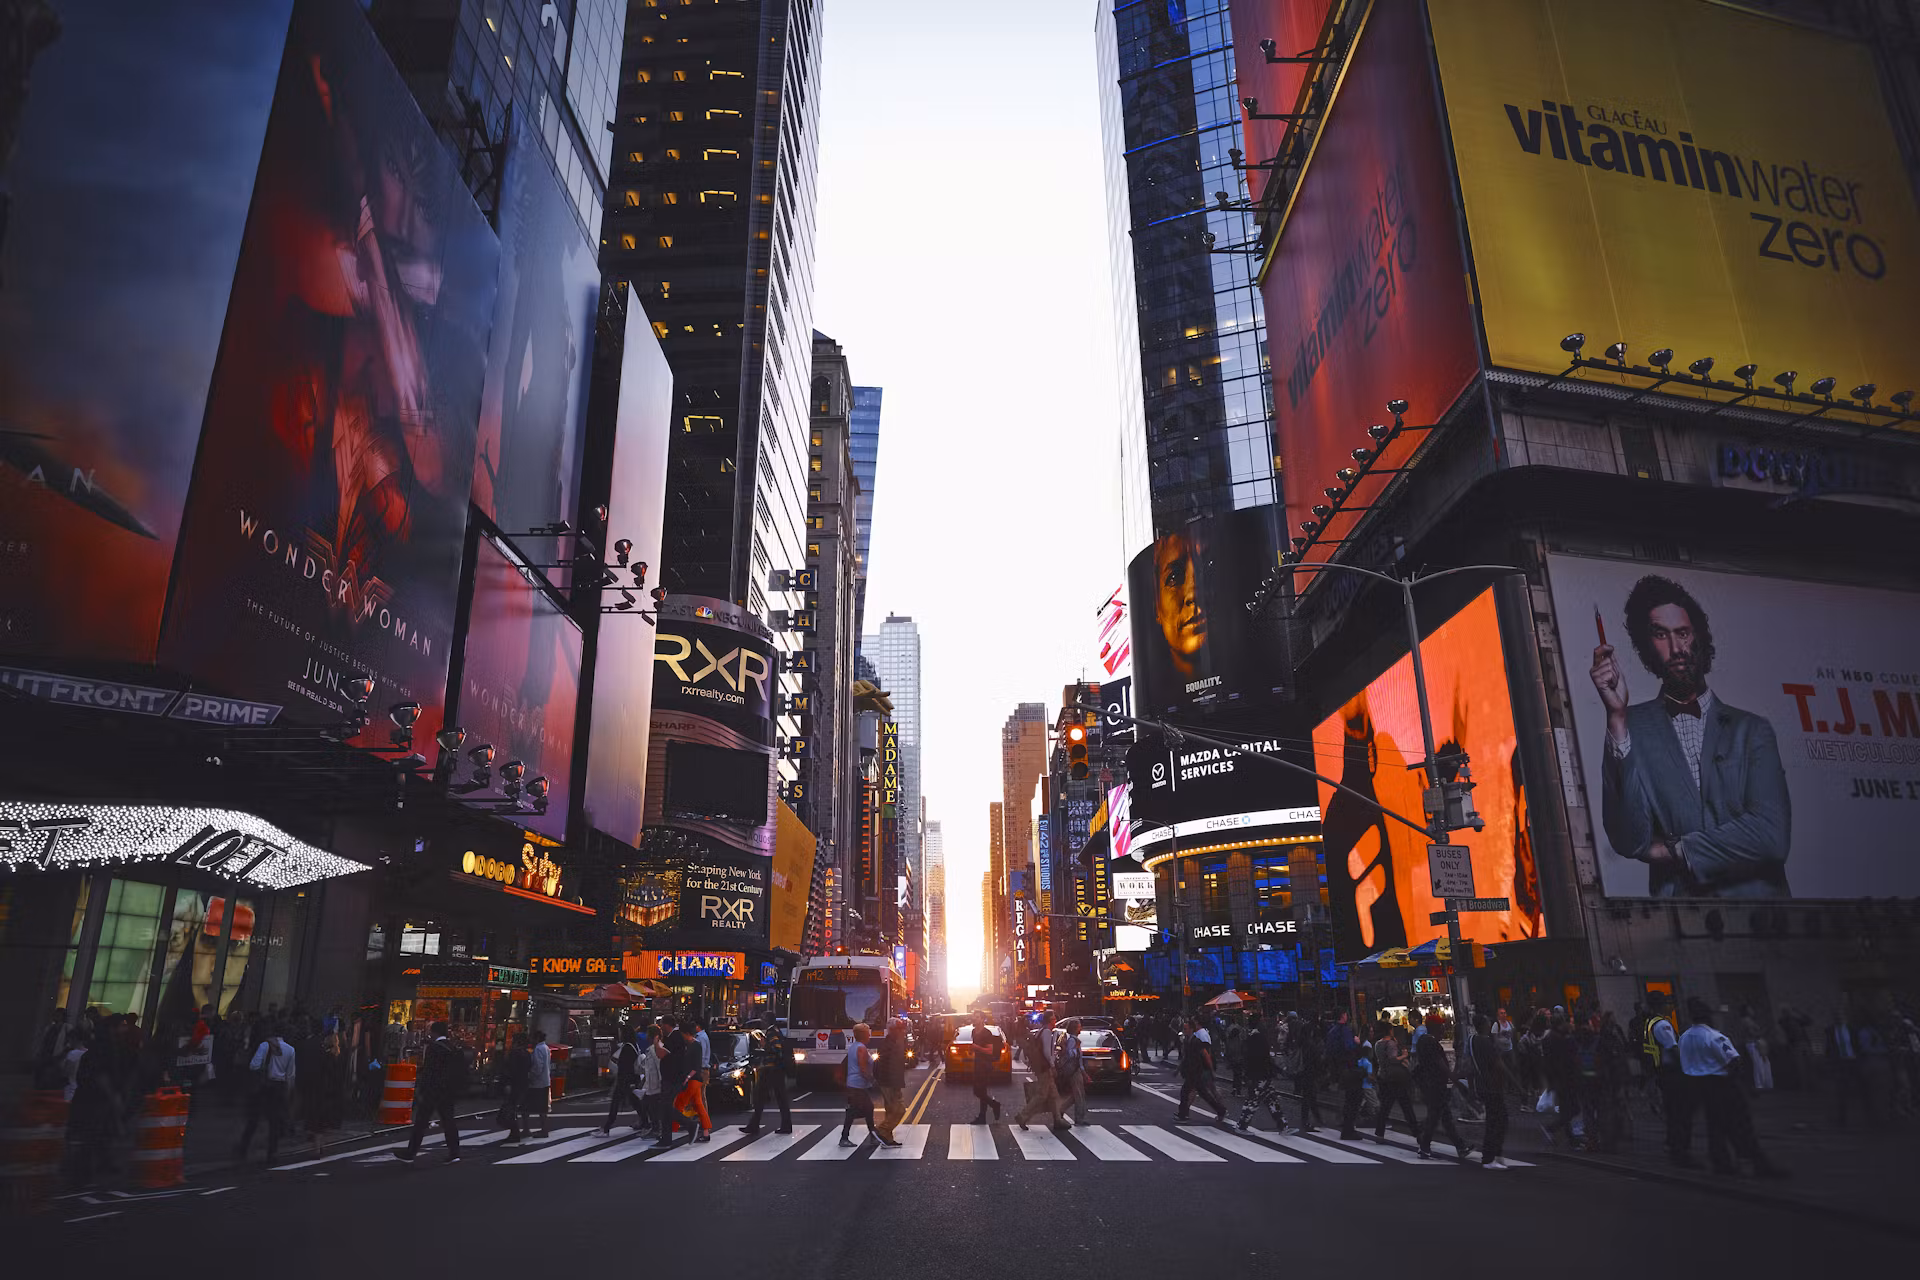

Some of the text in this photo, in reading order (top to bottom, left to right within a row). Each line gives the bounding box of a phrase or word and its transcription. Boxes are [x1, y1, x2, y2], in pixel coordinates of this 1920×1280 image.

[1750, 212, 1887, 280] zero
[1358, 212, 1417, 347] zero
[239, 509, 432, 657] WONDER WOMAN
[247, 598, 264, 615] THE
[269, 610, 300, 636] FUTURE
[305, 631, 316, 643] OF
[319, 639, 350, 664] JUSTICE
[352, 658, 378, 680] BEGINS
[382, 675, 398, 690] WITH
[654, 632, 768, 702] RXR
[1841, 669, 1874, 683] HBO
[1185, 675, 1223, 694] EQUALITY.
[681, 685, 745, 705] rxrrealty.com
[184, 697, 271, 726] PRIME
[470, 679, 526, 731] WONDER
[531, 723, 569, 758] WOMAN
[650, 721, 696, 732] SHARP
[883, 722, 898, 803] MADAME
[1180, 748, 1221, 767] MAZDA
[1181, 760, 1235, 781] SERVICES
[1851, 777, 1904, 801] JUNE
[1206, 816, 1240, 829] CHASE
[1152, 828, 1173, 841] CHASE
[1436, 849, 1462, 859] BUSES
[728, 866, 748, 879] New
[747, 868, 762, 881] York
[1040, 858, 1051, 890] STUDIOS
[1440, 861, 1460, 870] ONLY
[686, 877, 764, 897] for the 21st Century
[1095, 856, 1106, 901] VICTORY
[700, 894, 755, 922] RXR
[1469, 900, 1507, 910] Broadway
[711, 919, 746, 929] REALTY
[1015, 899, 1026, 962] REGAL
[1194, 925, 1231, 939] CHASE
[1248, 920, 1297, 935] CHASE
[543, 958, 582, 973] KNOW
[658, 955, 736, 975] CHAMPS
[1415, 979, 1440, 993] SODA
